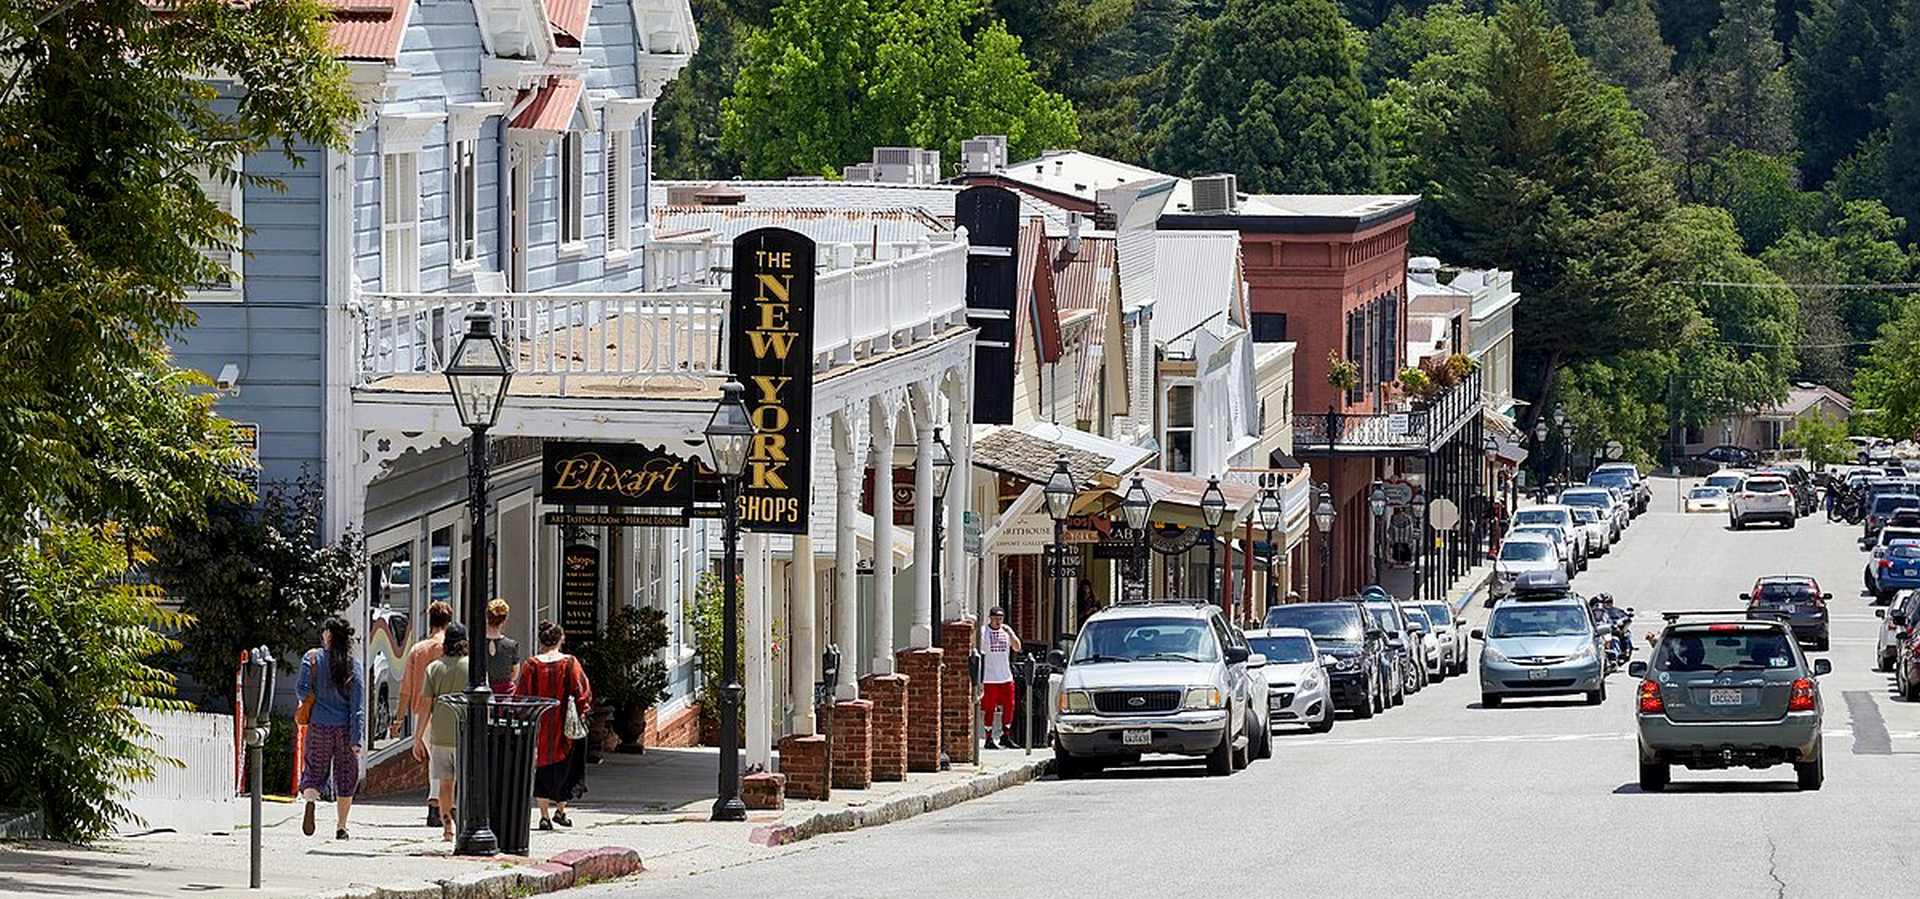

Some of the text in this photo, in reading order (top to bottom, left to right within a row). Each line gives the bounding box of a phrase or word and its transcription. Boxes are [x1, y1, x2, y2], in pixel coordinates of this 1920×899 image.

[756, 251, 792, 268] THE
[745, 274, 799, 490] NEW YORK
[554, 452, 684, 499] Elixart
[738, 495, 799, 523] SHOPS
[1047, 556, 1081, 566] PAKING
[1050, 567, 1077, 577] SOPS
